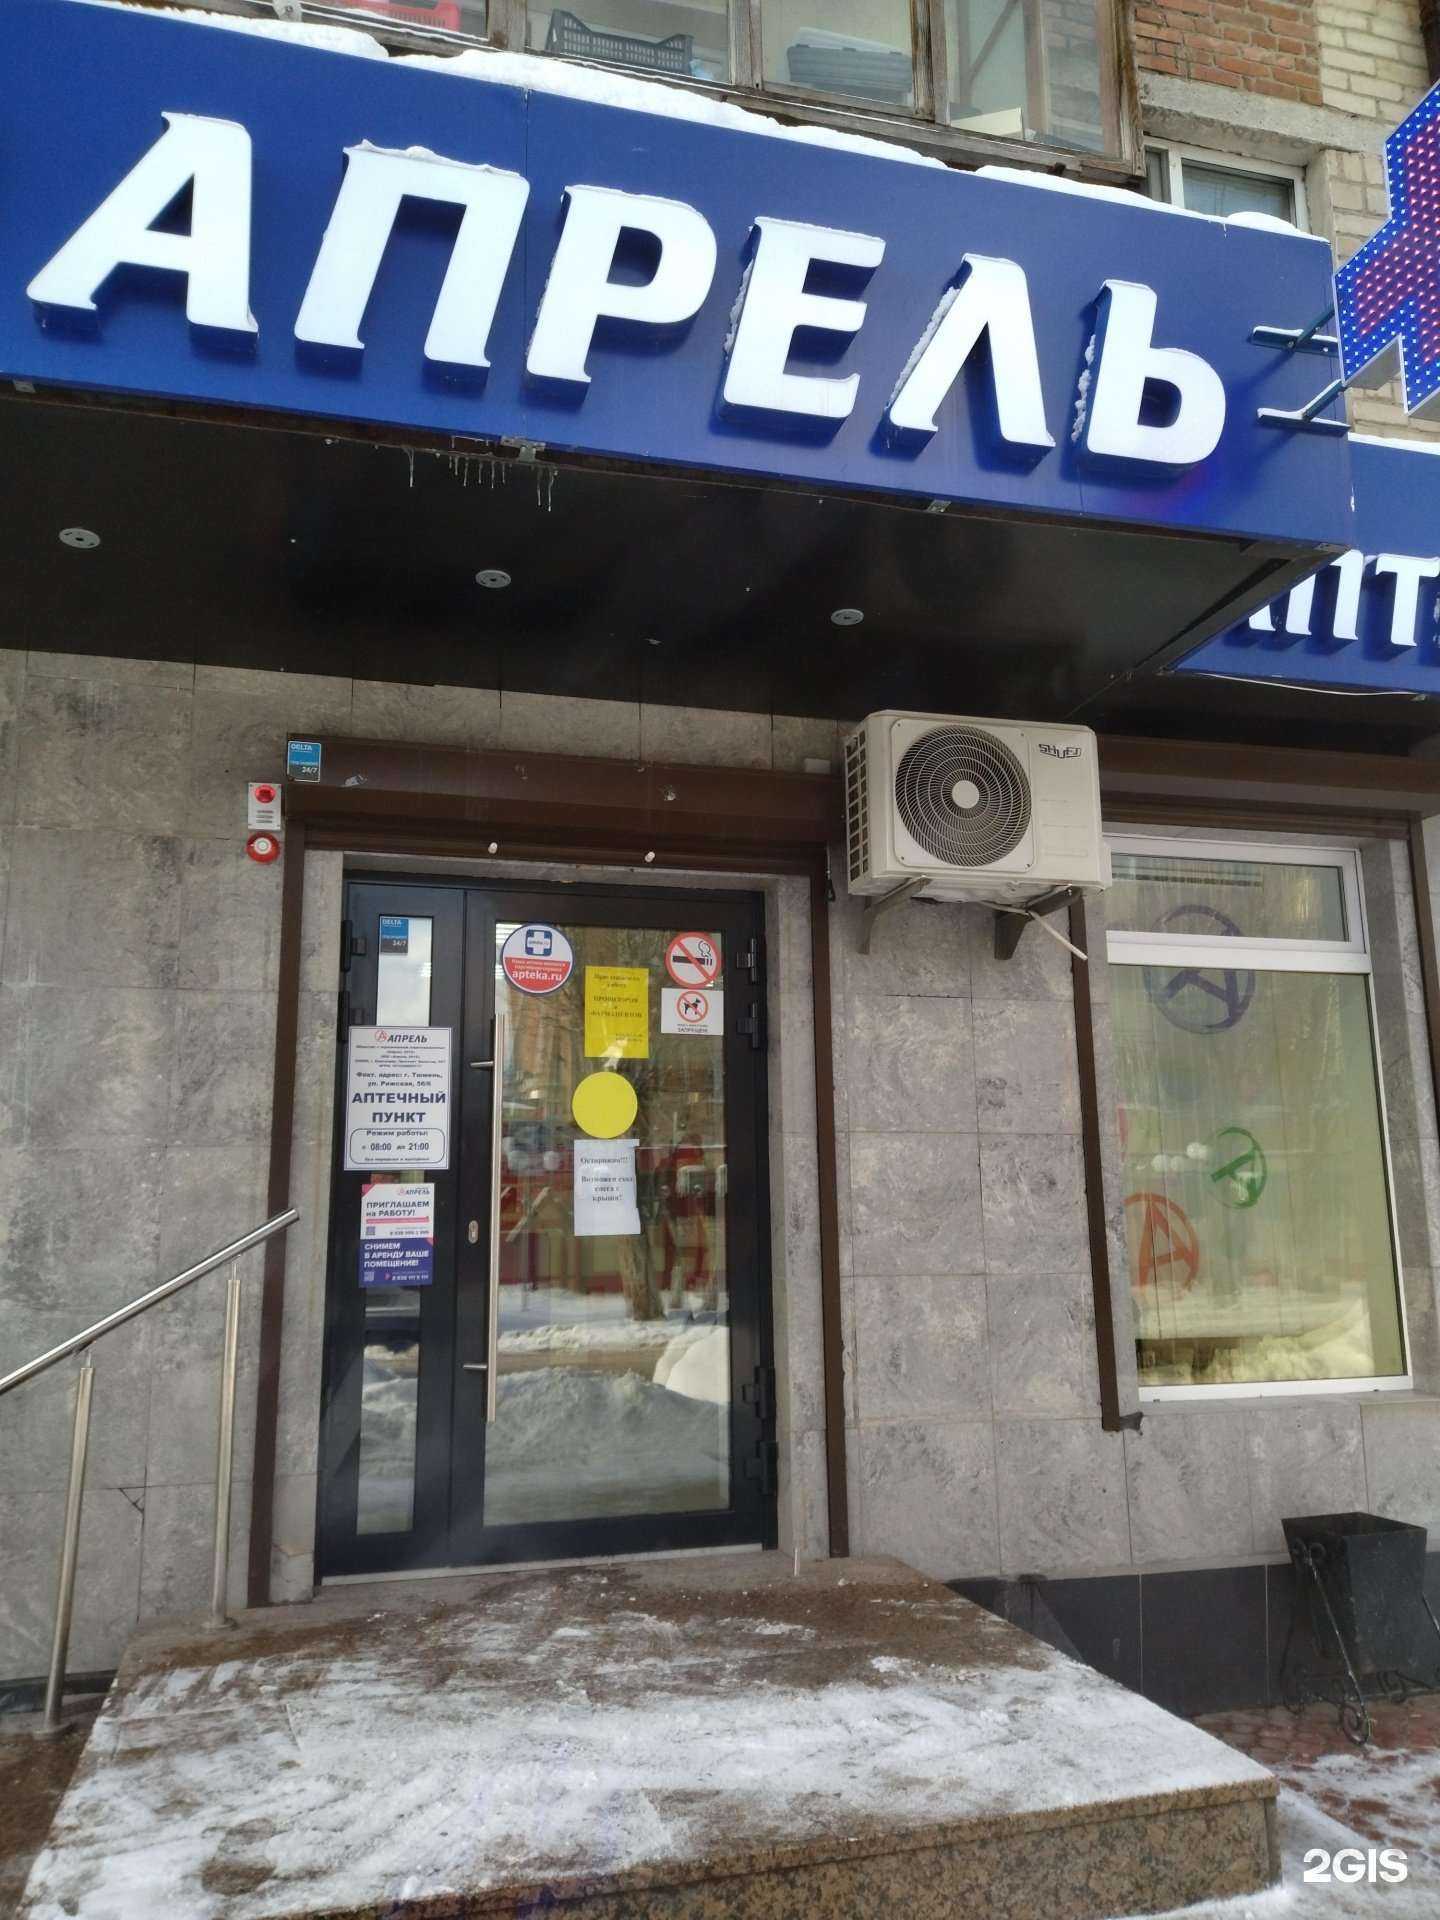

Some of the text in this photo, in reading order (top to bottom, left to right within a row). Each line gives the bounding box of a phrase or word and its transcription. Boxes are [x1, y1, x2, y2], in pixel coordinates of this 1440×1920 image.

[26, 111, 1226, 466] АПРЕЛЬ
[291, 743, 312, 751] DELTA
[302, 766, 318, 774] 24/7
[512, 970, 562, 981] apteka.ru
[387, 1034, 428, 1043] АПРЕЛЬ
[352, 1090, 446, 1104] АПТЕЧНЫЙ
[372, 1111, 426, 1123] ПУНКТ
[396, 1129, 428, 1137] работы:
[370, 1142, 392, 1151] 08:00
[408, 1142, 430, 1151] 21:00
[405, 1188, 430, 1196] АПРЕЛЬ
[366, 1201, 430, 1209] ПРИГЛАШАЕМ
[378, 1209, 416, 1217] РАБОТУ!
[364, 1242, 401, 1251] СНИМЕМ
[372, 1251, 403, 1259] АРЕНДУ
[405, 1250, 430, 1258] ВАШЕ
[363, 1259, 419, 1268] ПОМЕЩЕНИЕ!
